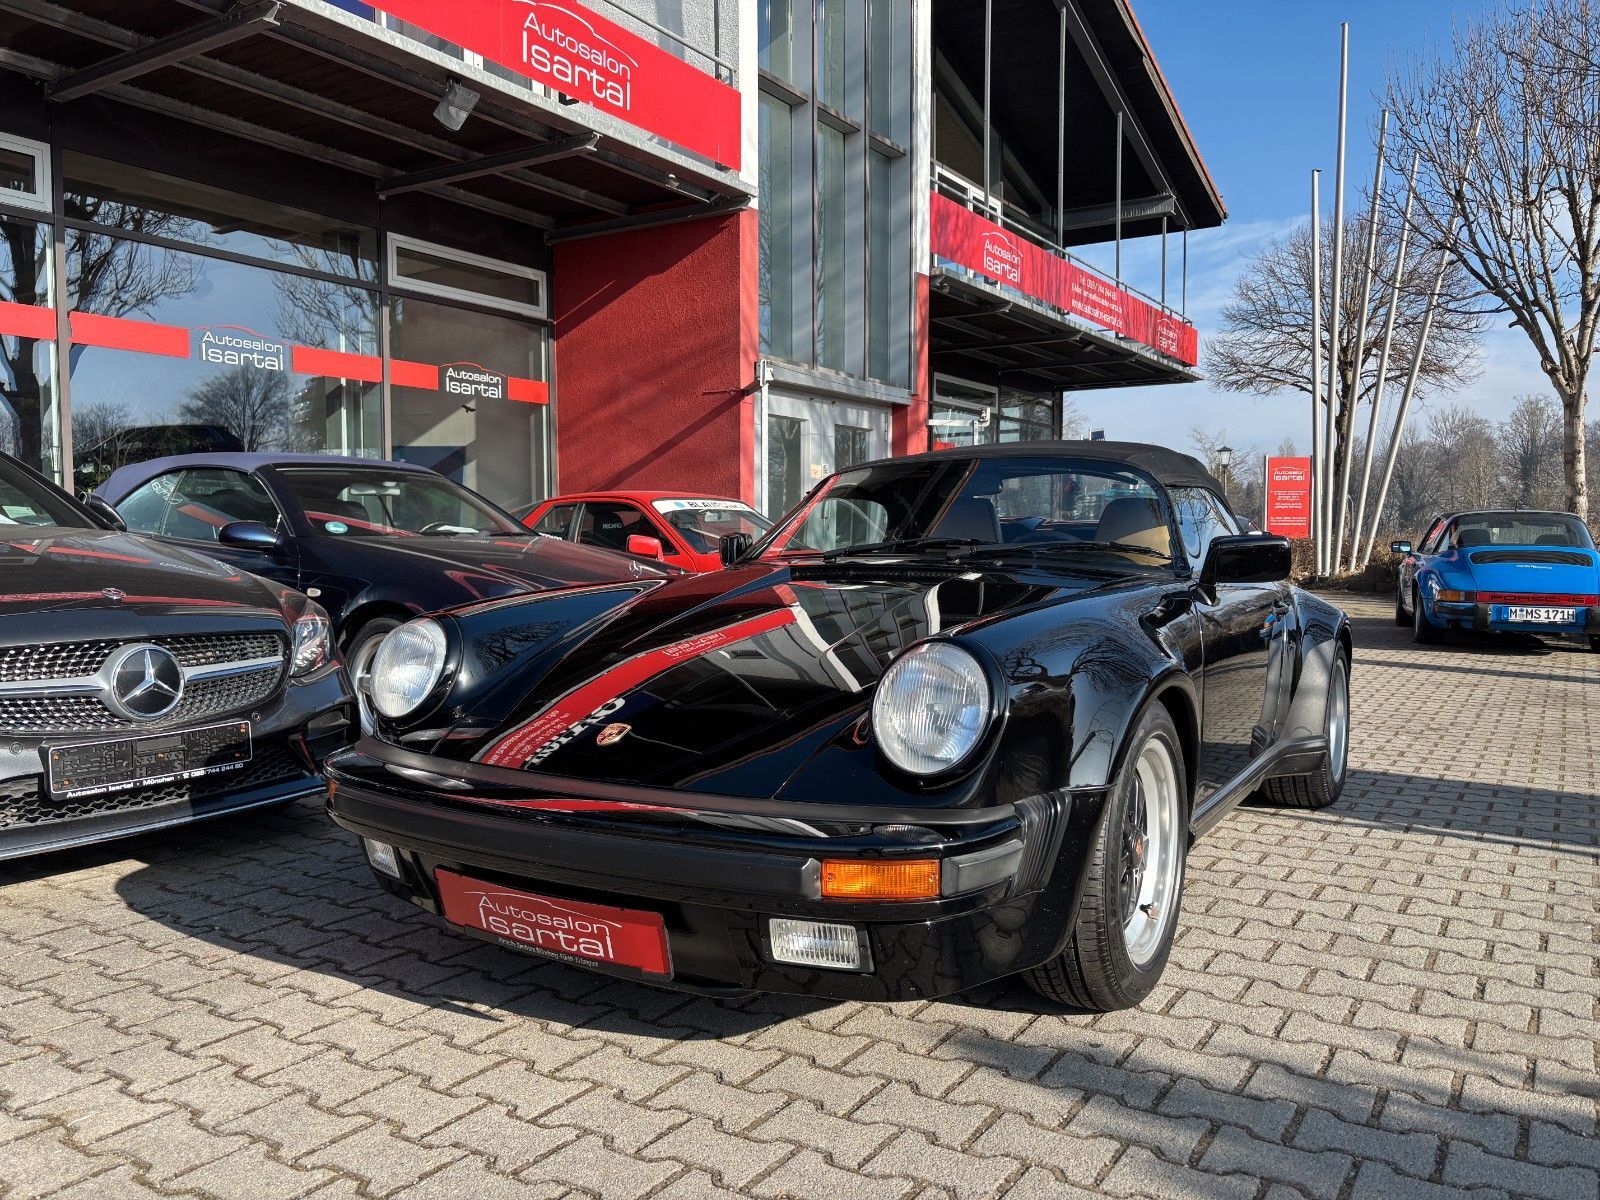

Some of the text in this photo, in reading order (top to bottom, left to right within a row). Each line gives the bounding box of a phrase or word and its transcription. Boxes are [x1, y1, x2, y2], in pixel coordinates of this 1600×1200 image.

[523, 12, 630, 80] Autosalon
[522, 30, 630, 110] Isartal
[985, 239, 1021, 265] Autosalon
[984, 250, 1020, 283] Isartal
[202, 332, 283, 353] Autosalon
[202, 343, 284, 370] Isartal
[446, 367, 502, 384] Autosalon
[446, 377, 502, 398] Isartal
[1490, 595, 1586, 604] PORSCHE
[1544, 609, 1575, 621] 171H
[66, 787, 107, 798] Autosalon
[109, 782, 134, 791] Isartal
[142, 776, 175, 786] München
[479, 895, 610, 936] Autosalon
[480, 907, 614, 959] Isartal
